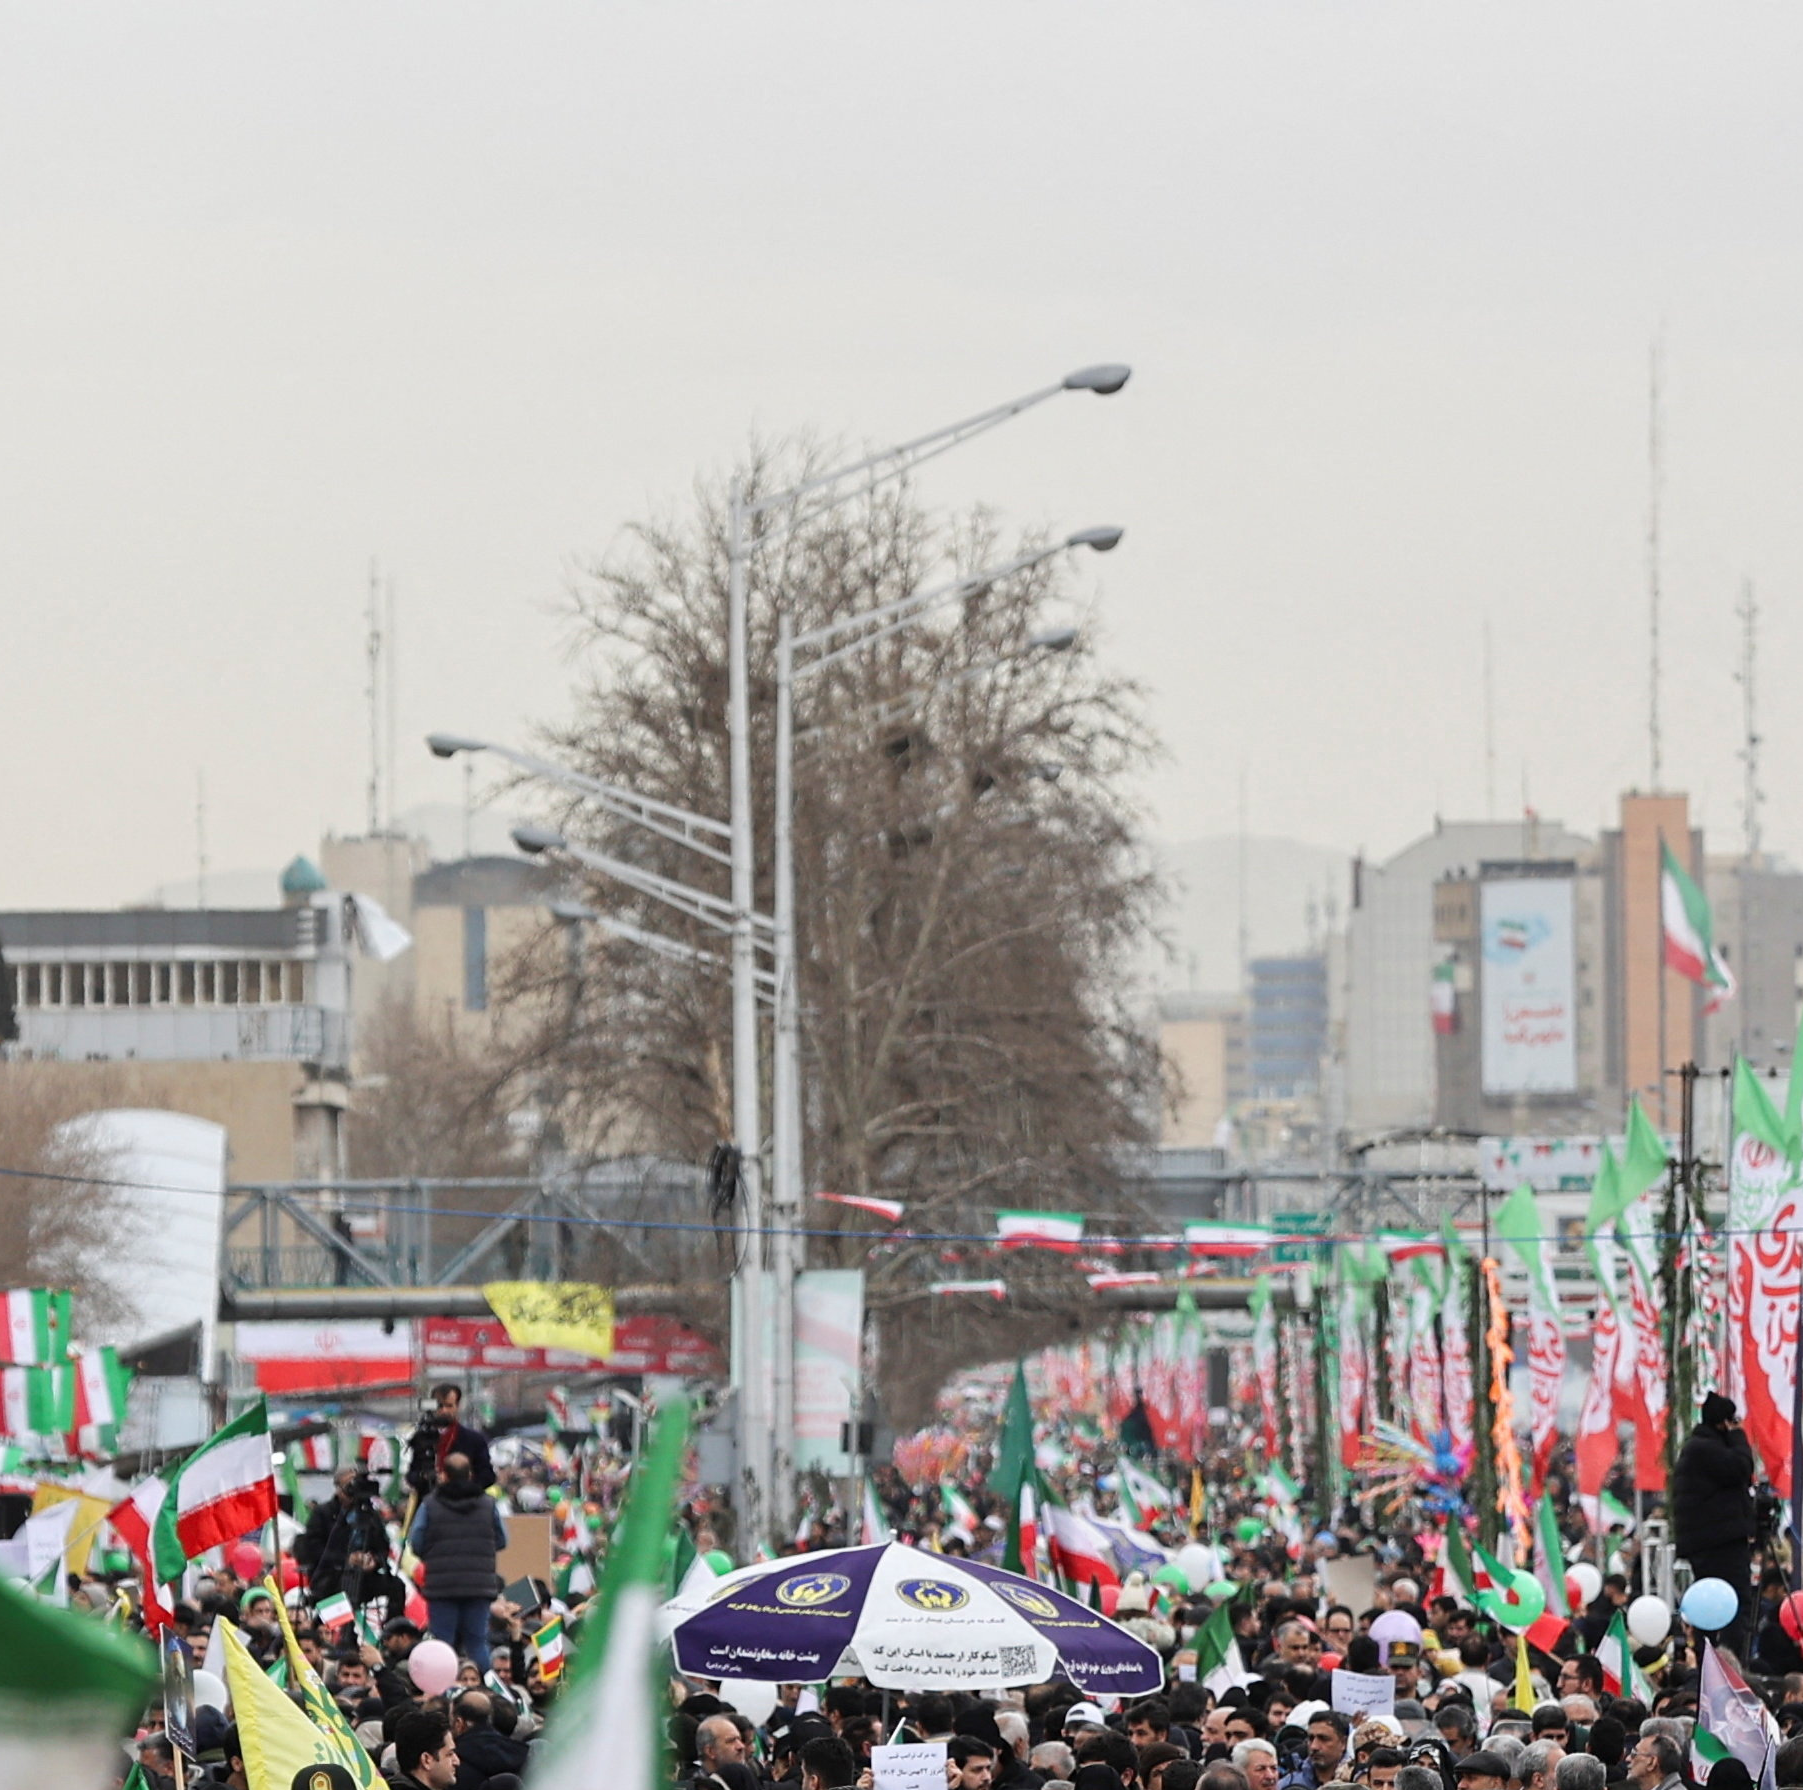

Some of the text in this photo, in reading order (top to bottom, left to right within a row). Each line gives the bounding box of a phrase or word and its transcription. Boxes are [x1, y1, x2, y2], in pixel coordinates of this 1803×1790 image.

[710, 1644, 821, 1664] بهشت خانه سخاوتمندان است
[871, 1645, 997, 1663] نیکوکار ارجمند با اسکن این کد
[890, 1663, 920, 1675] پرداخت
[920, 1665, 942, 1677] آسانی
[961, 1669, 977, 1679] خود
[978, 1668, 1000, 1677] صدقه
[900, 1751, 917, 1760] ترامپ
[917, 1751, 930, 1760] مرگ
[896, 1768, 908, 1777] سال
